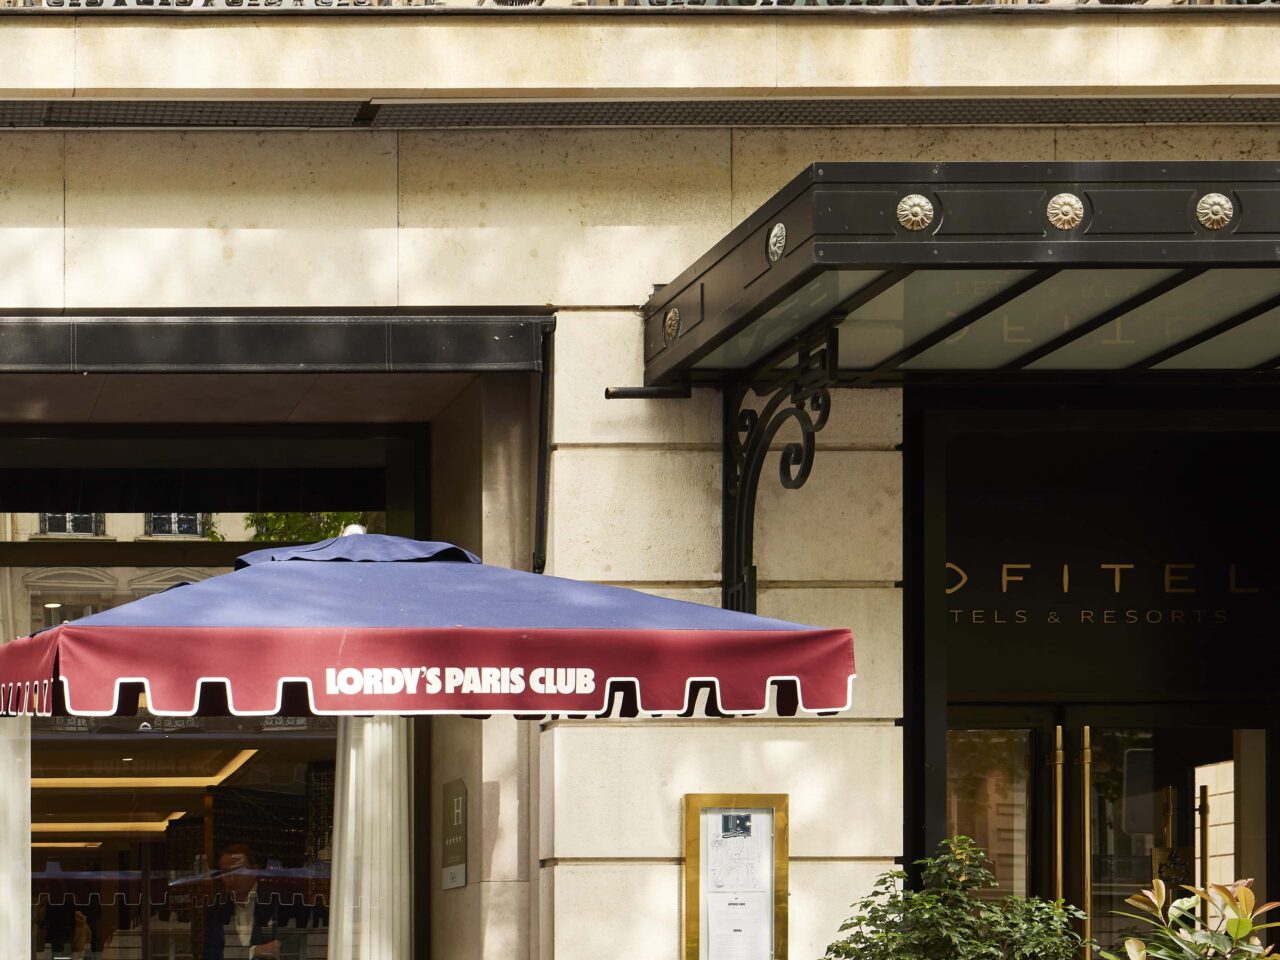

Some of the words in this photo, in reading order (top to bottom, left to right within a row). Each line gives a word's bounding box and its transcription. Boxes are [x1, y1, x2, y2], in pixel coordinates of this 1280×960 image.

[950, 609, 1029, 624] TELS
[1047, 610, 1061, 624] &
[1080, 609, 1228, 624] RESORTS
[326, 666, 442, 695] LORDY'S
[445, 667, 526, 694] PARIS
[529, 667, 596, 694] CLUB
[453, 796, 463, 826] H
